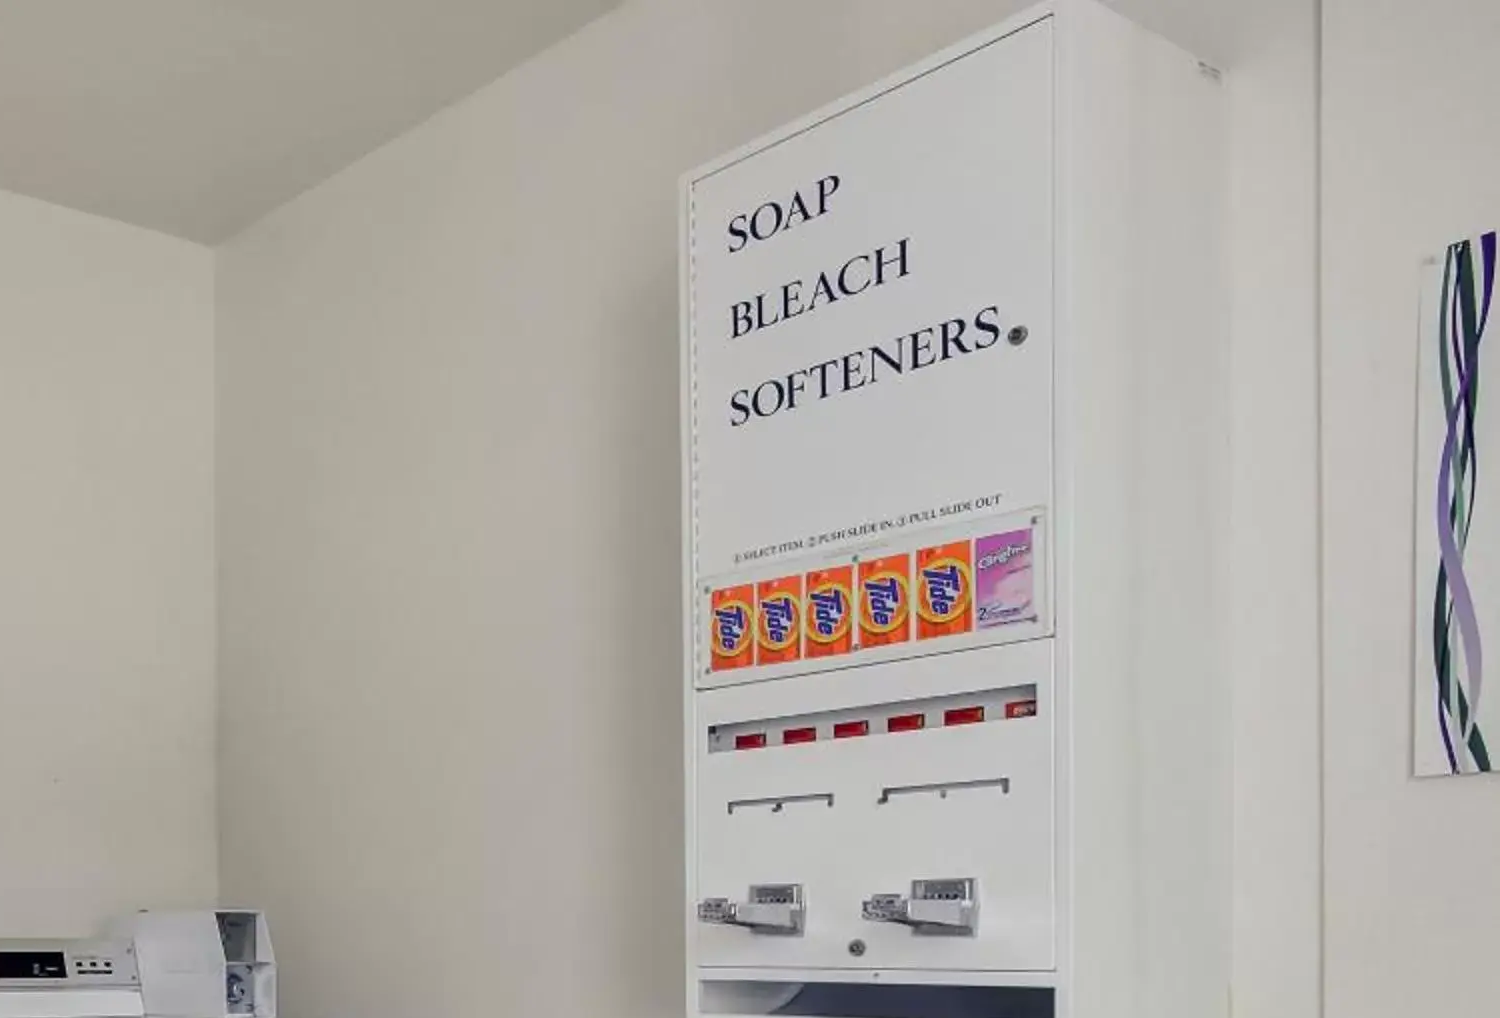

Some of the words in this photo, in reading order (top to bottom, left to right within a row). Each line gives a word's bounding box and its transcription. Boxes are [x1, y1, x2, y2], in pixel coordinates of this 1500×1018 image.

[728, 175, 840, 253] SOAP
[731, 238, 910, 339] BLEACH
[731, 306, 1001, 427] SOFTENERS
[975, 493, 1002, 509] OUT
[809, 588, 843, 635] Tide
[863, 577, 899, 625] Tide
[922, 565, 960, 615] Tide
[715, 605, 744, 651] Tide
[761, 597, 793, 643] Tide
